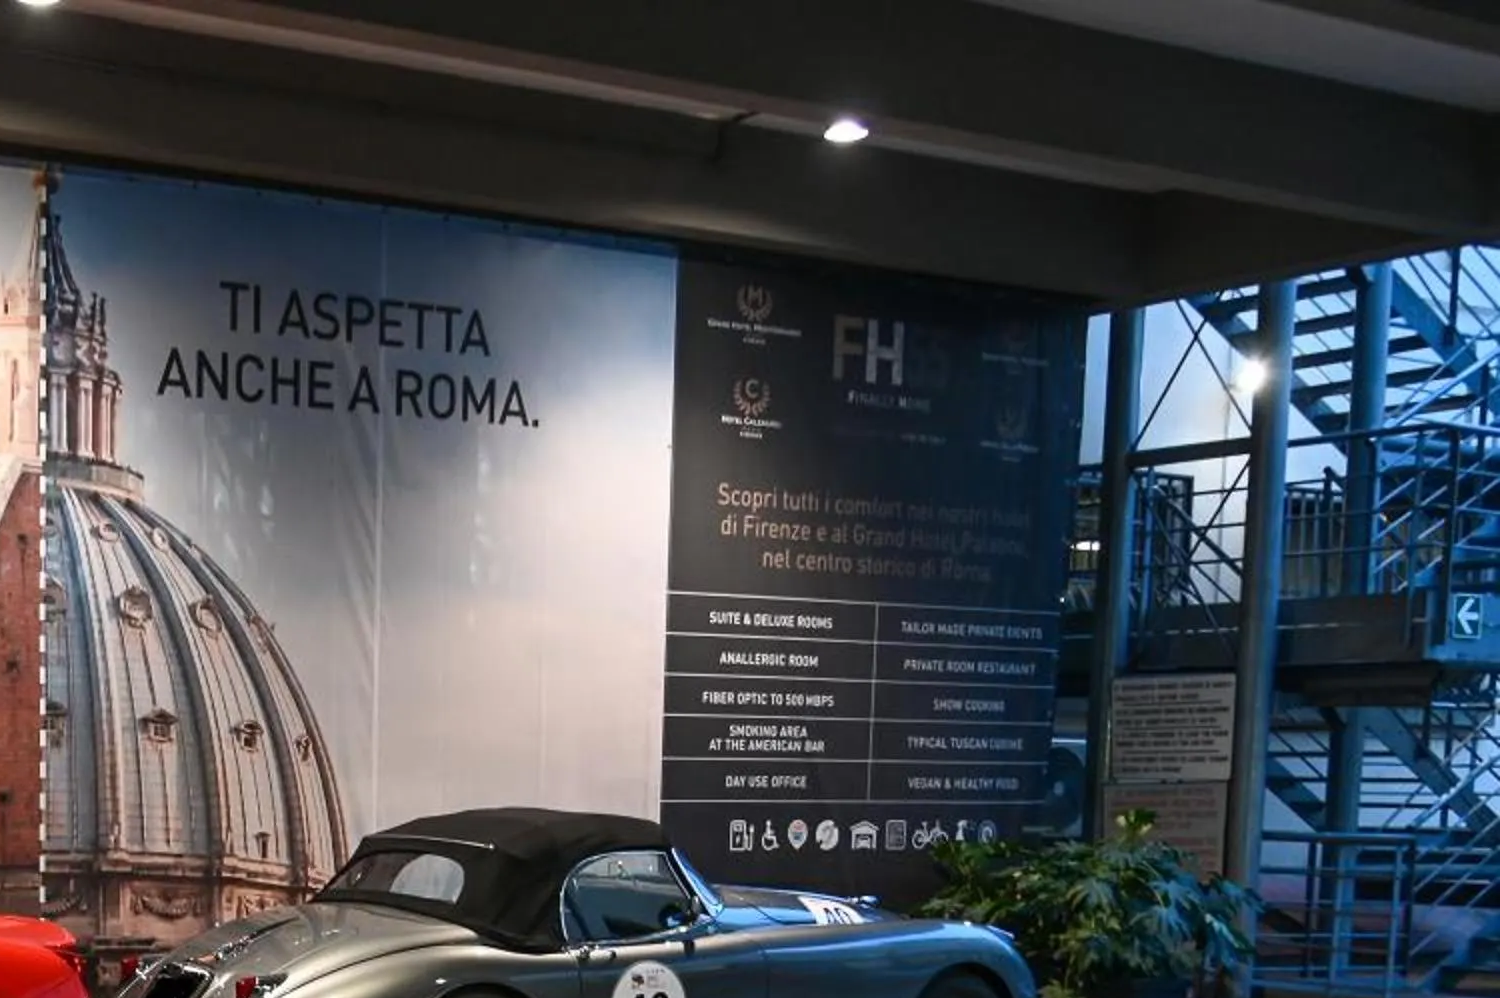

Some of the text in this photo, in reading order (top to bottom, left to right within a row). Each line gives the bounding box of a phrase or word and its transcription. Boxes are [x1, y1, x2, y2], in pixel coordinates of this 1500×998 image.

[220, 281, 491, 356] TI ASPETTA
[157, 347, 539, 428] ANCHE A ROMA.
[744, 378, 760, 399] C
[717, 482, 778, 512] Scopri
[783, 490, 819, 513] tutti
[825, 489, 830, 513] i
[835, 494, 904, 519] comfort
[721, 514, 737, 536] di
[743, 514, 811, 541] Firenze
[817, 525, 828, 542] e
[831, 523, 847, 544] al
[853, 523, 905, 548] Grand
[762, 550, 791, 569] nel
[796, 553, 852, 574] centro
[857, 556, 917, 578] storico
[921, 557, 936, 579] di
[709, 611, 833, 629] SUITE & DELUXE ROOMS
[901, 621, 935, 634] TAILOR
[938, 623, 966, 636] MADE
[968, 624, 1005, 638] PRIVATE
[719, 651, 819, 667] ANALLERGIC ROOM
[903, 659, 1036, 675] PRIVATE ROOM RESTAURANT
[702, 692, 735, 705] FIBER
[737, 693, 768, 705] OPTIC
[770, 694, 783, 705] TO
[785, 694, 804, 706] 500
[729, 725, 808, 738] SMOKING AREA
[708, 738, 825, 752] AT THE AMERICAN BAR
[907, 736, 947, 749] TYPICAL
[950, 737, 988, 750] TUSCAN
[725, 775, 807, 789] DAY USE OFFICE
[908, 777, 941, 790] VEGAN
